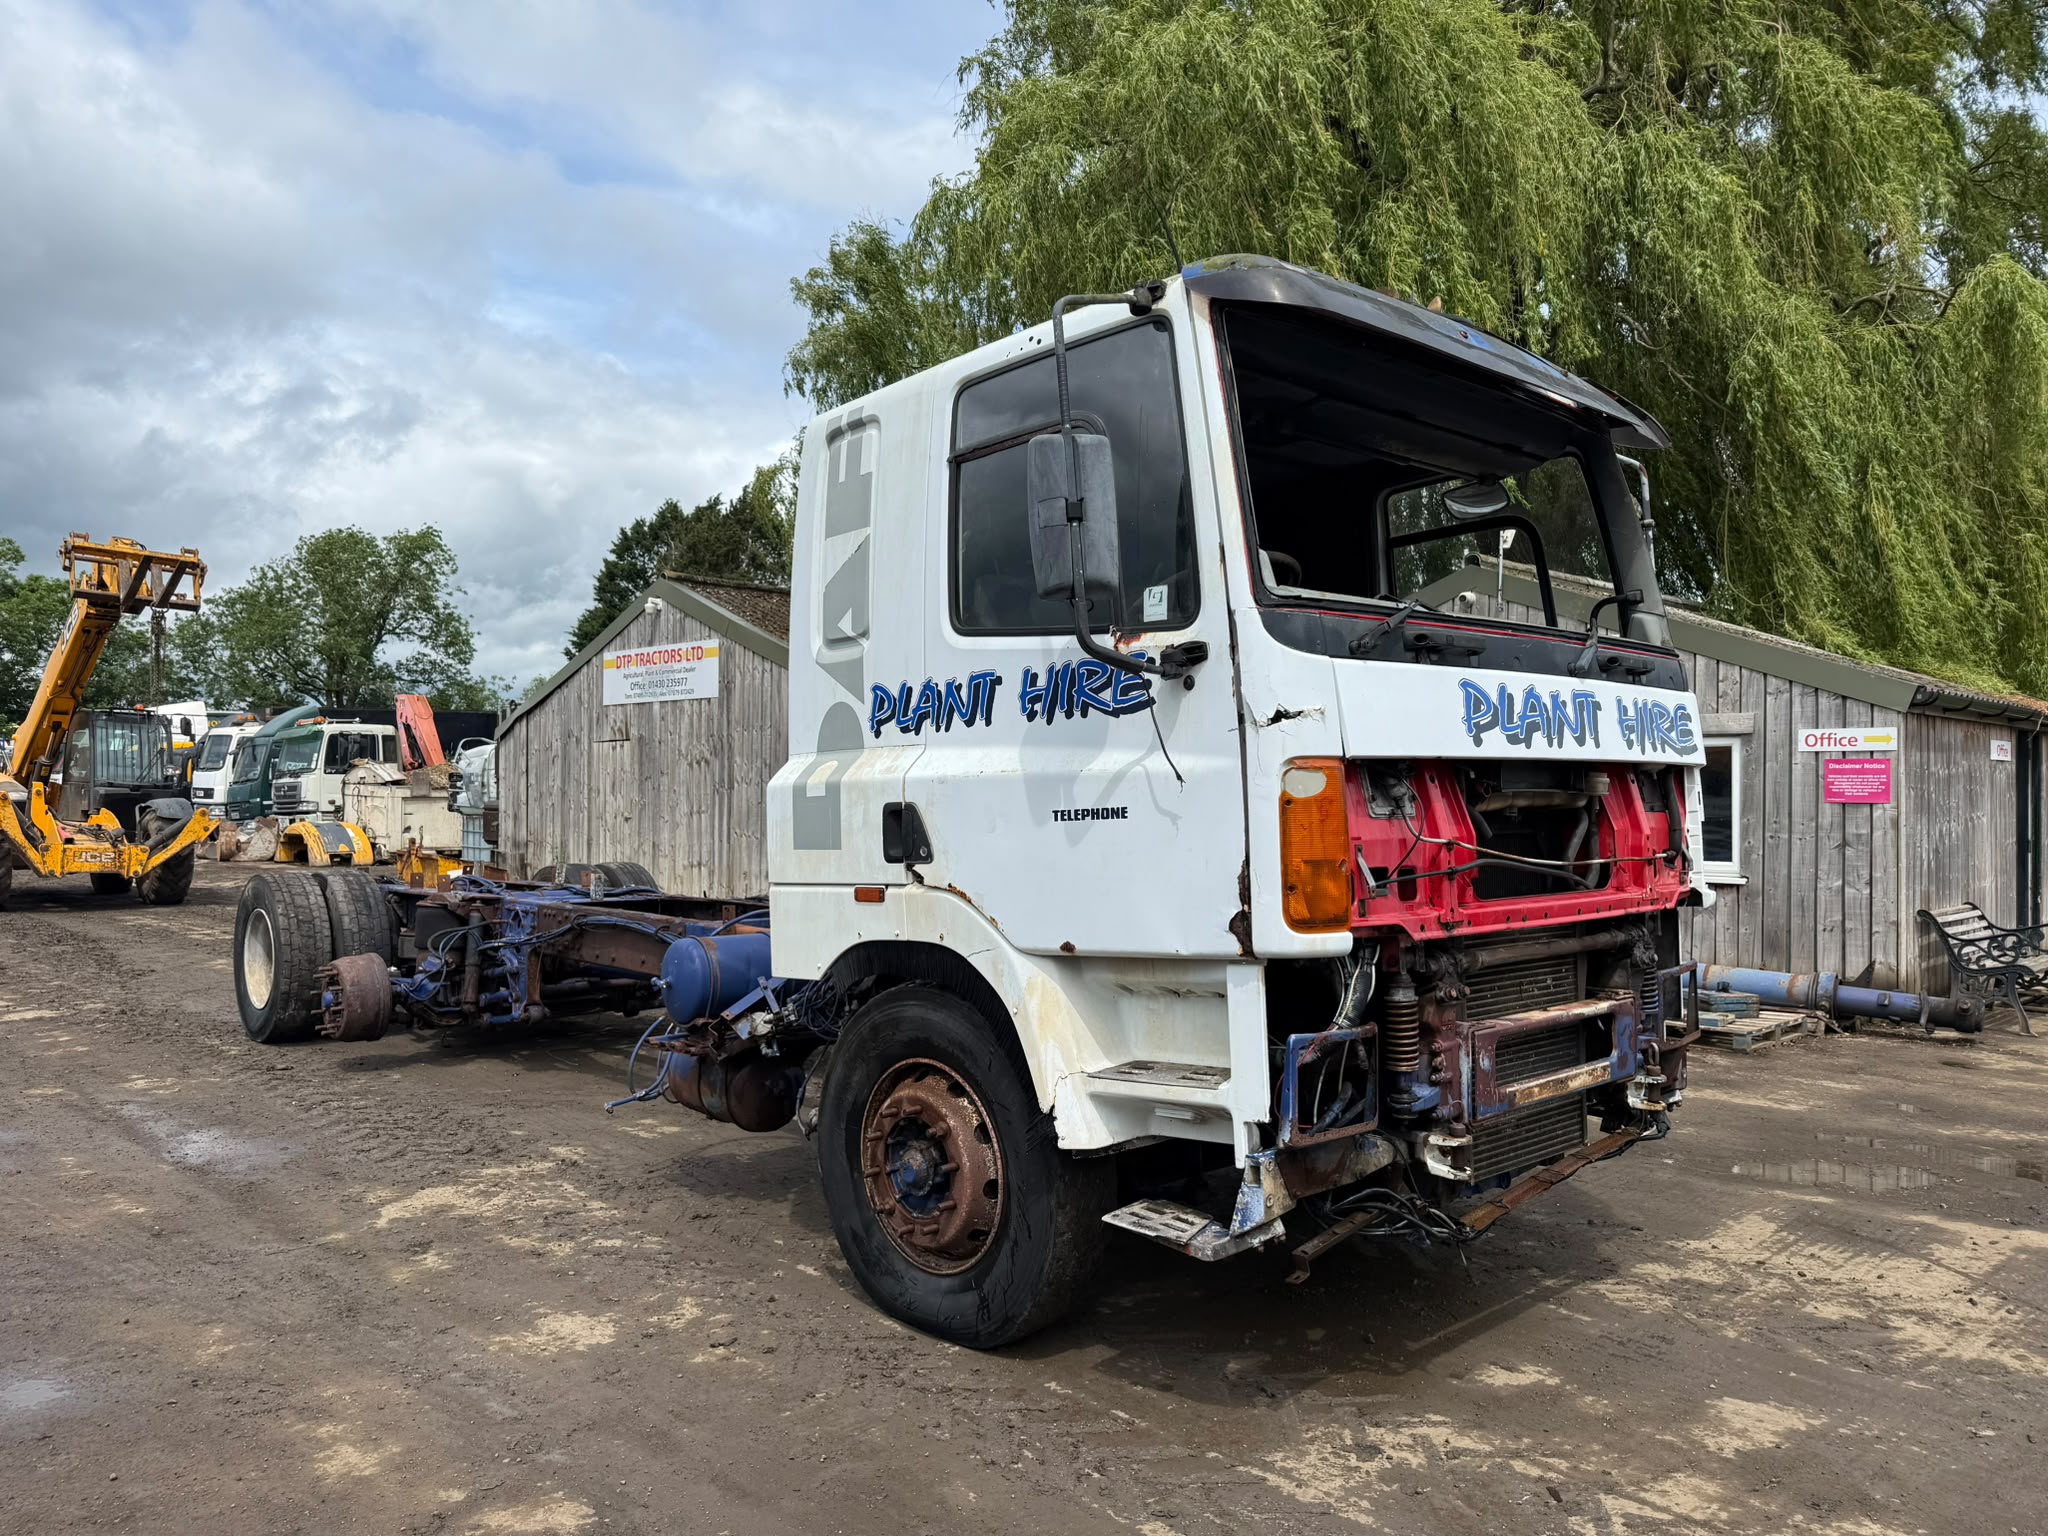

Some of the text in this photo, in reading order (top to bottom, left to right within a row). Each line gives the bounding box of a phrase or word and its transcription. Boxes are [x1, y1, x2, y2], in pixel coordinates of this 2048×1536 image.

[61, 602, 79, 652] JCB
[616, 646, 704, 669] DTP TRACTORS LTD
[630, 677, 688, 691] Office: 01430 235977
[870, 649, 1156, 739] PLANT HIRE
[1458, 677, 1699, 757] PLANT HIRE
[1804, 733, 1858, 748] Office
[1052, 806, 1129, 822] TELEPHONE
